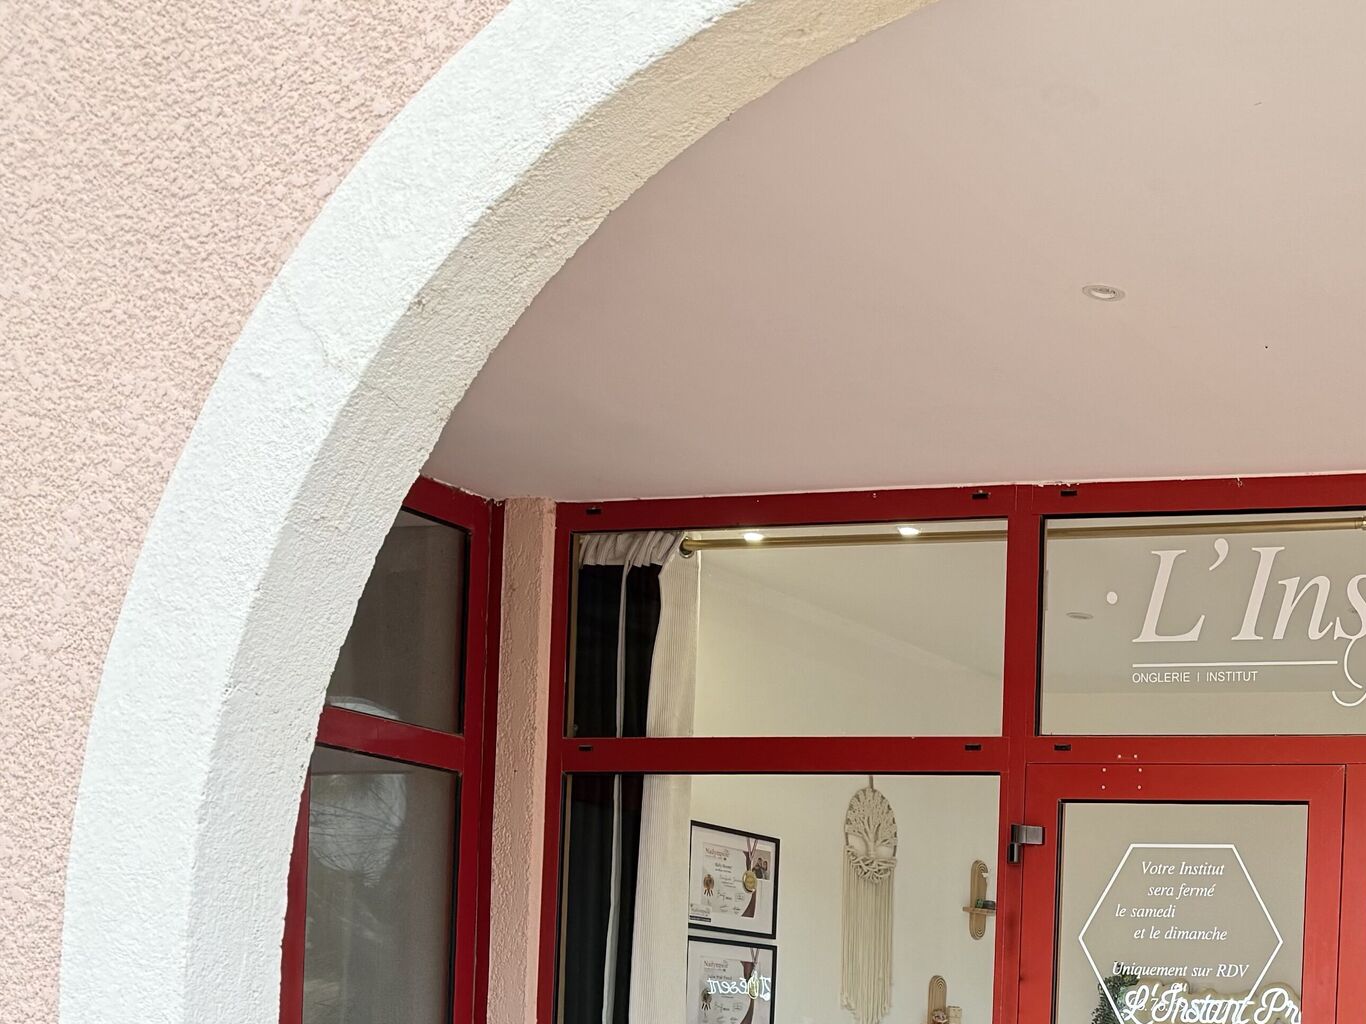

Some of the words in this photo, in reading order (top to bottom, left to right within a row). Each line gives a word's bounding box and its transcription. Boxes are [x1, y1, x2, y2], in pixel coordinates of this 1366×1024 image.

[1132, 671, 1191, 683] ONGLERIE
[1206, 671, 1258, 682] INSTITUT
[1141, 861, 1174, 875] Votre
[1179, 861, 1225, 876] Institut
[1147, 885, 1174, 896] sera
[1176, 883, 1216, 900] fermé
[1115, 904, 1126, 917] le
[1130, 905, 1176, 918] samedi
[1133, 927, 1146, 939] et
[1149, 926, 1160, 939] le
[1164, 926, 1228, 941] dimanche
[1112, 961, 1187, 979] Uniquement
[1191, 965, 1213, 977] sur
[1216, 964, 1250, 978] RDV
